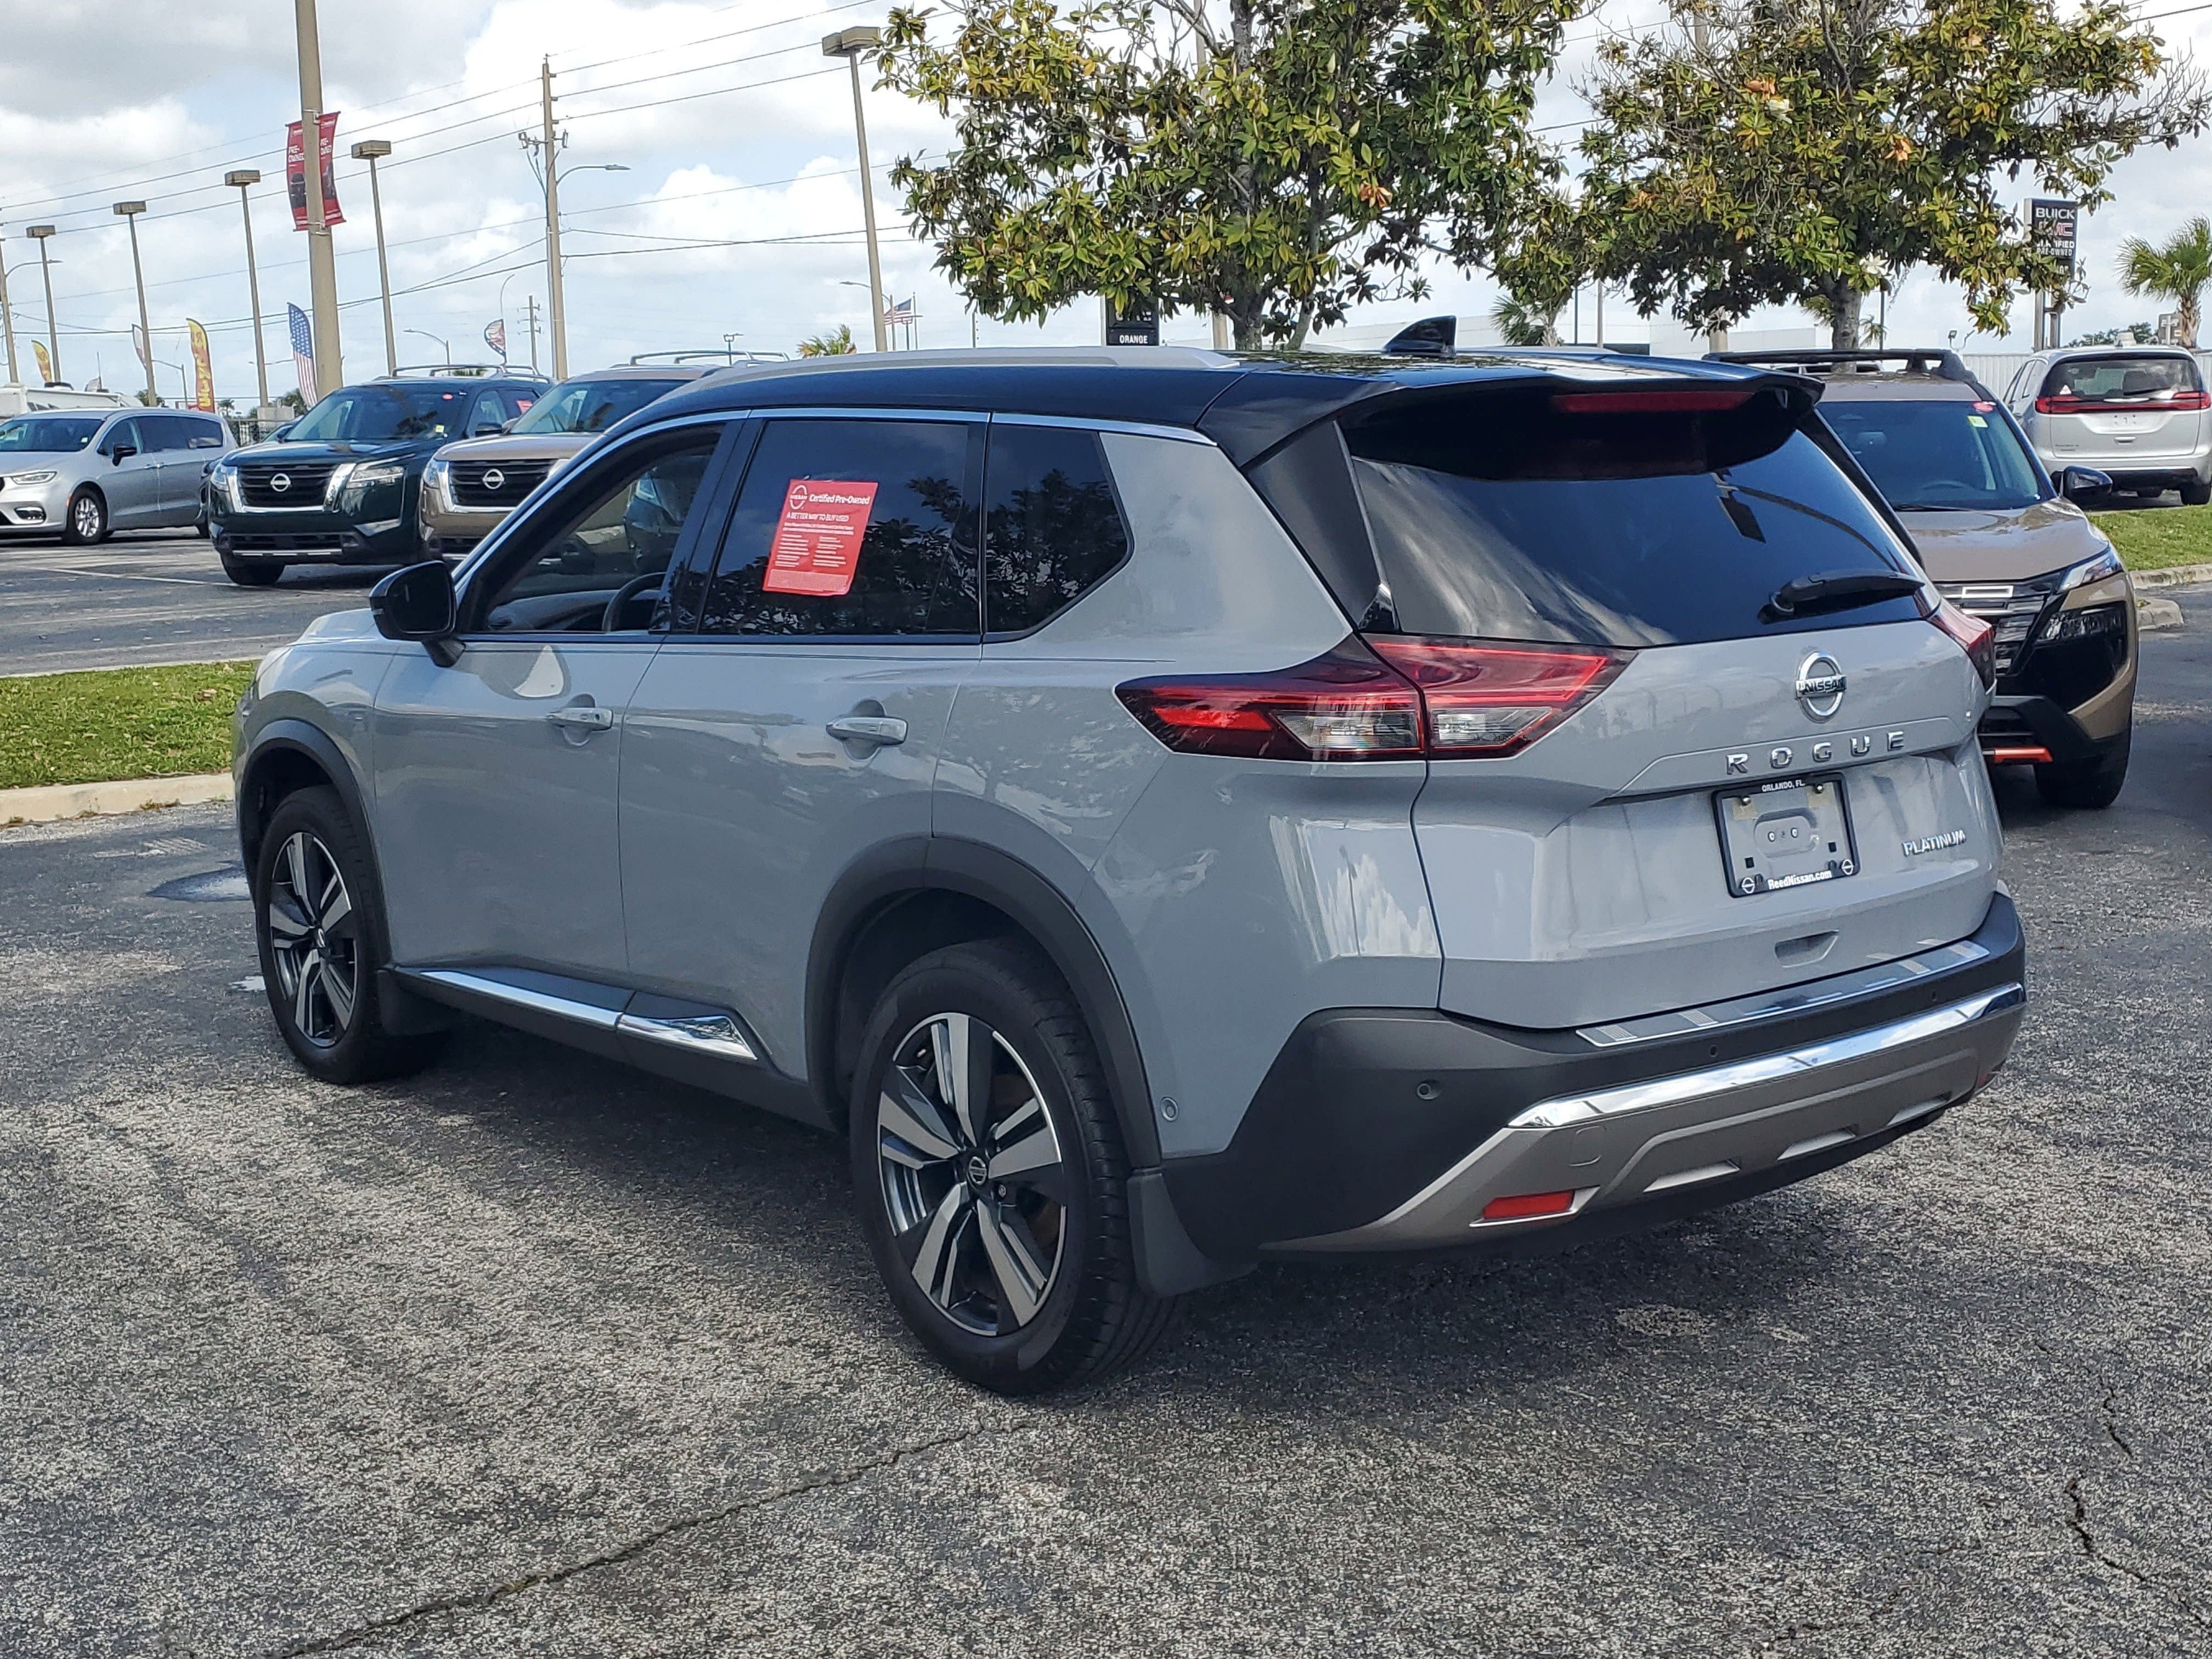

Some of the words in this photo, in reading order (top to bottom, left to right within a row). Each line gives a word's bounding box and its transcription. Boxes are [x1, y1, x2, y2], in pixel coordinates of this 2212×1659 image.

[2036, 207, 2075, 219] BUICK
[1119, 335, 1148, 344] ORANGE
[809, 494, 835, 503] Certified
[835, 495, 871, 505] Pre-Owned
[1803, 678, 1844, 692] NISSAN
[1726, 730, 1905, 775] ROGUE
[1762, 781, 1795, 792] ORLANDO,
[1902, 830, 1966, 857] PLATINUM
[1768, 870, 1832, 890] ReedNissan.com
